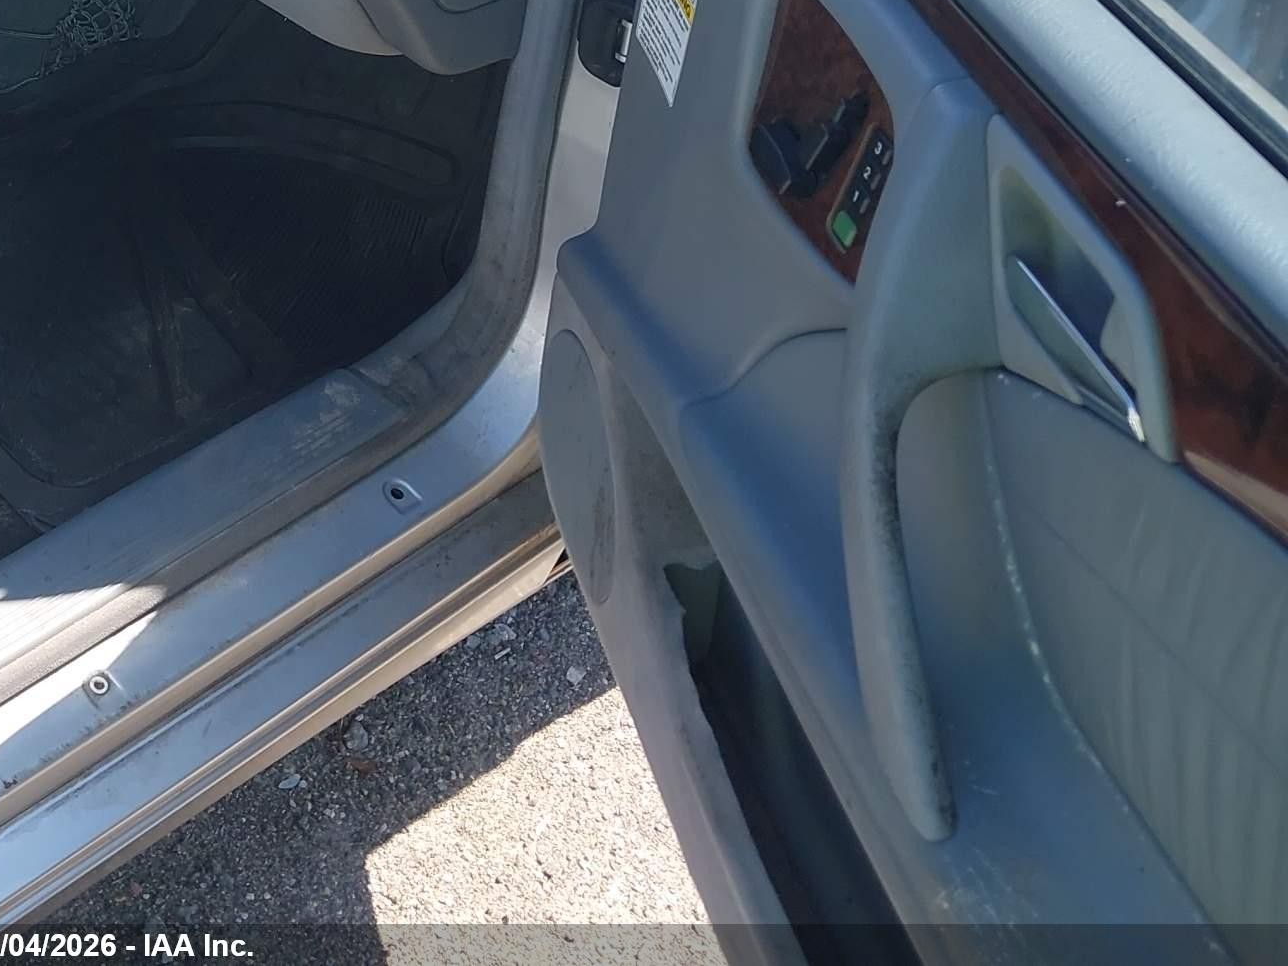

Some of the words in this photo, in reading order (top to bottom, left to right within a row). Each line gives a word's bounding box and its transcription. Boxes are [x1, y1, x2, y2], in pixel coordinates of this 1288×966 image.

[874, 141, 883, 155] 3
[863, 167, 872, 180] 2
[852, 191, 860, 203] 1
